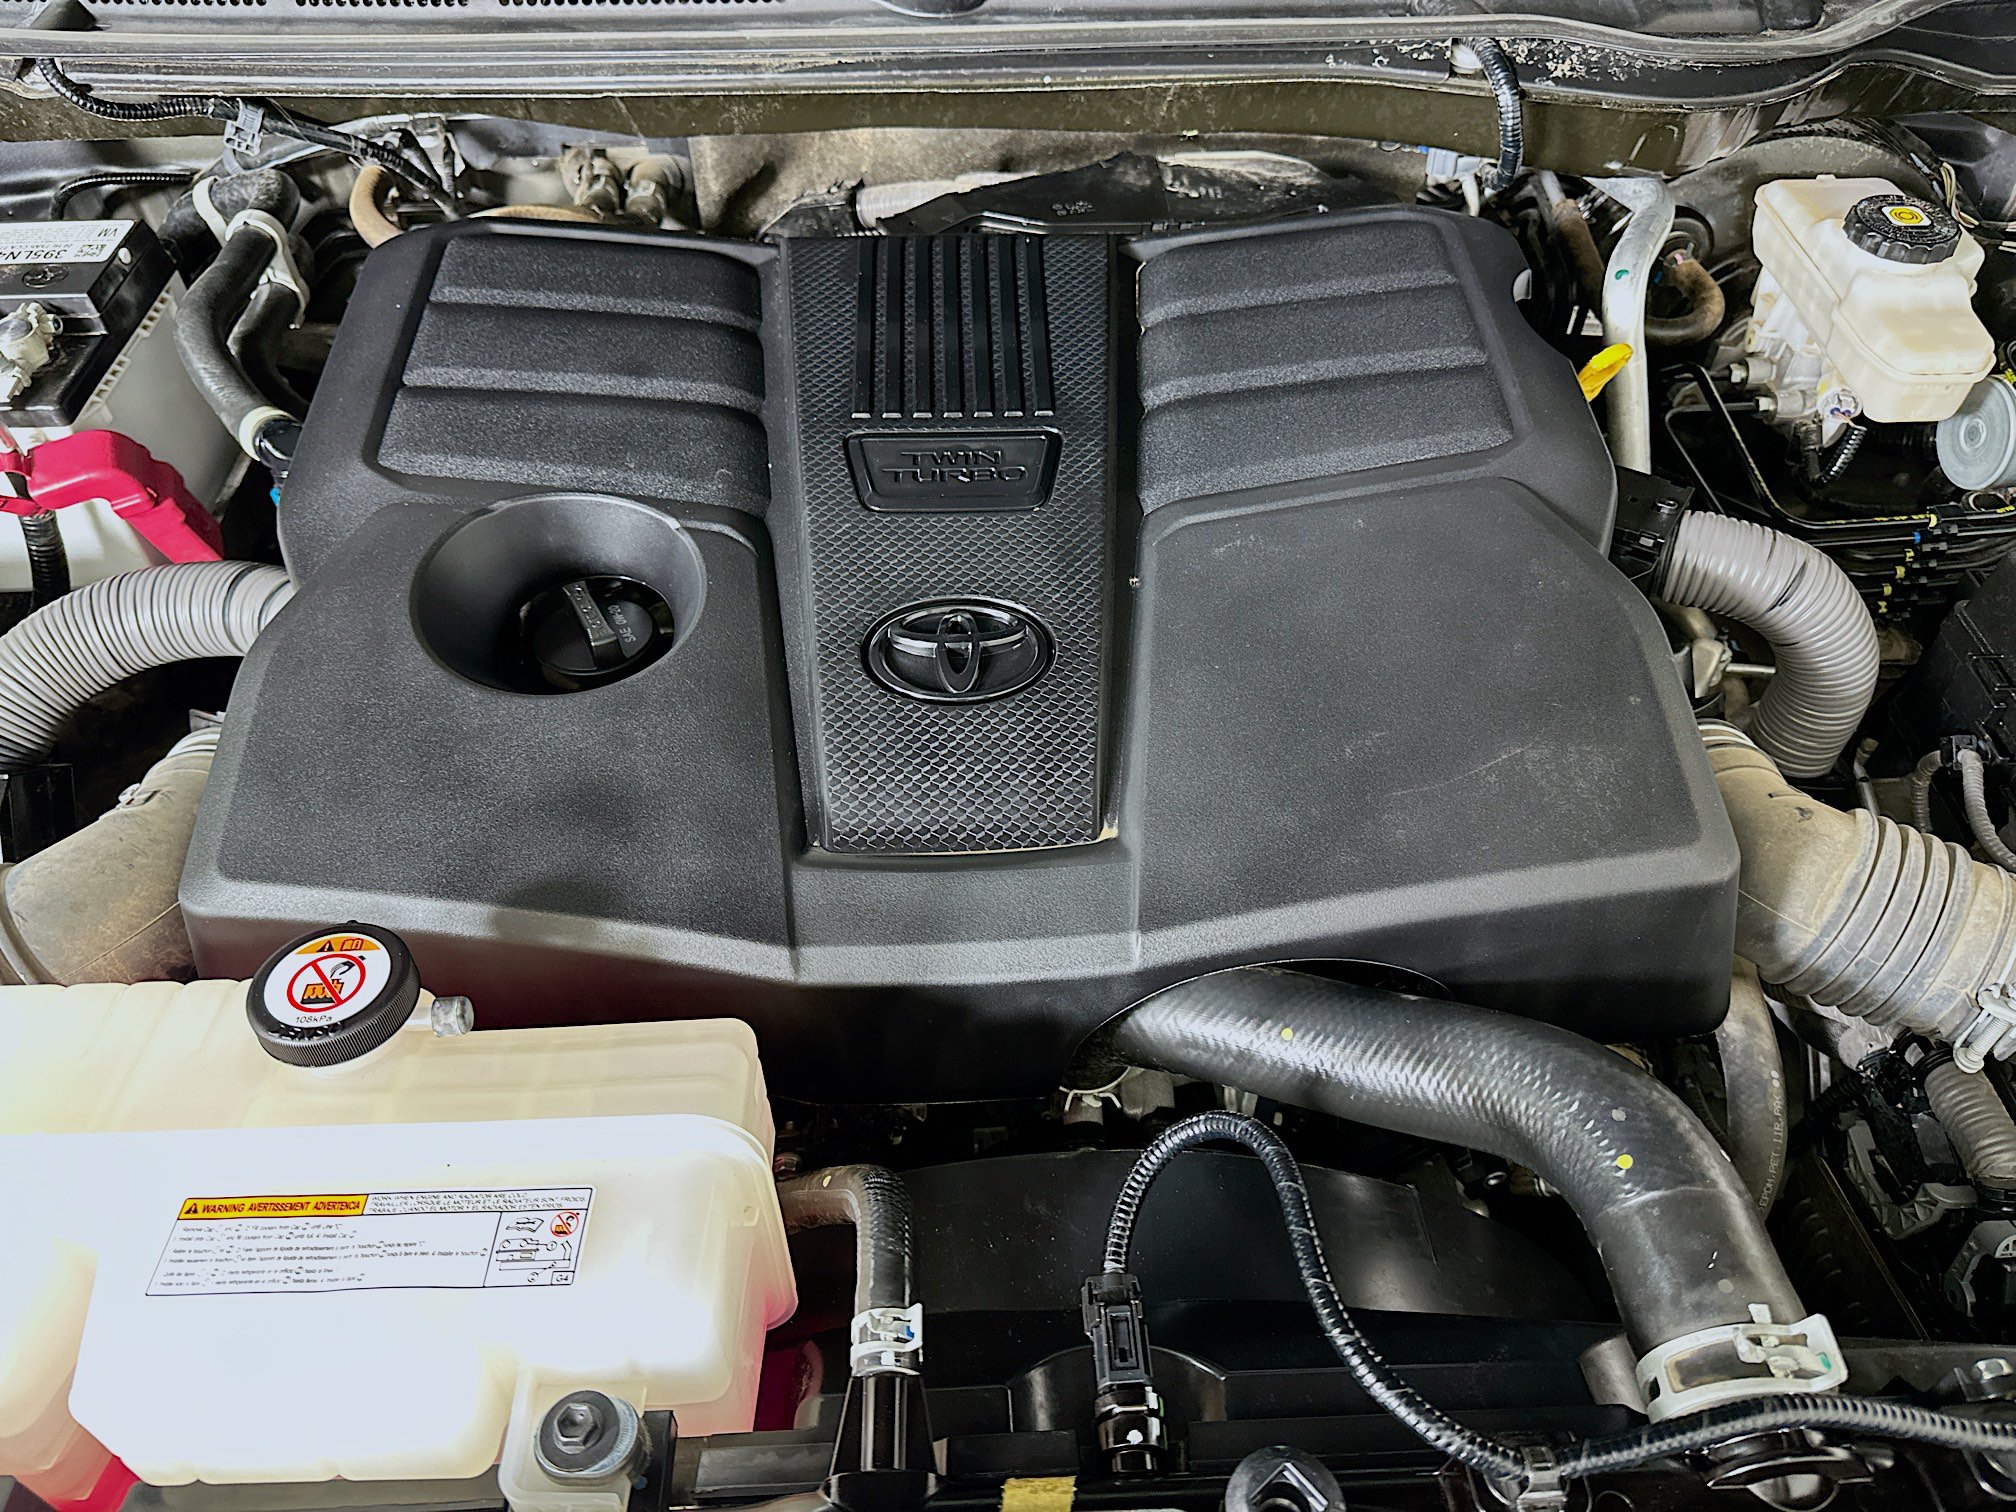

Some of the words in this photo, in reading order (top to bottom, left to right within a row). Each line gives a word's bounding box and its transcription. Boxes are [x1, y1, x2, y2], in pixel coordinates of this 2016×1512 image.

[97, 228, 118, 237] VM
[901, 450, 1002, 465] TWIN
[882, 466, 1028, 482] TURBO
[608, 604, 627, 625] 0W-20
[620, 627, 636, 643] SAE
[202, 1203, 245, 1214] WARNING
[248, 1202, 310, 1212] AVERTISSEMENT
[313, 1200, 360, 1211] ADVERTENCIA
